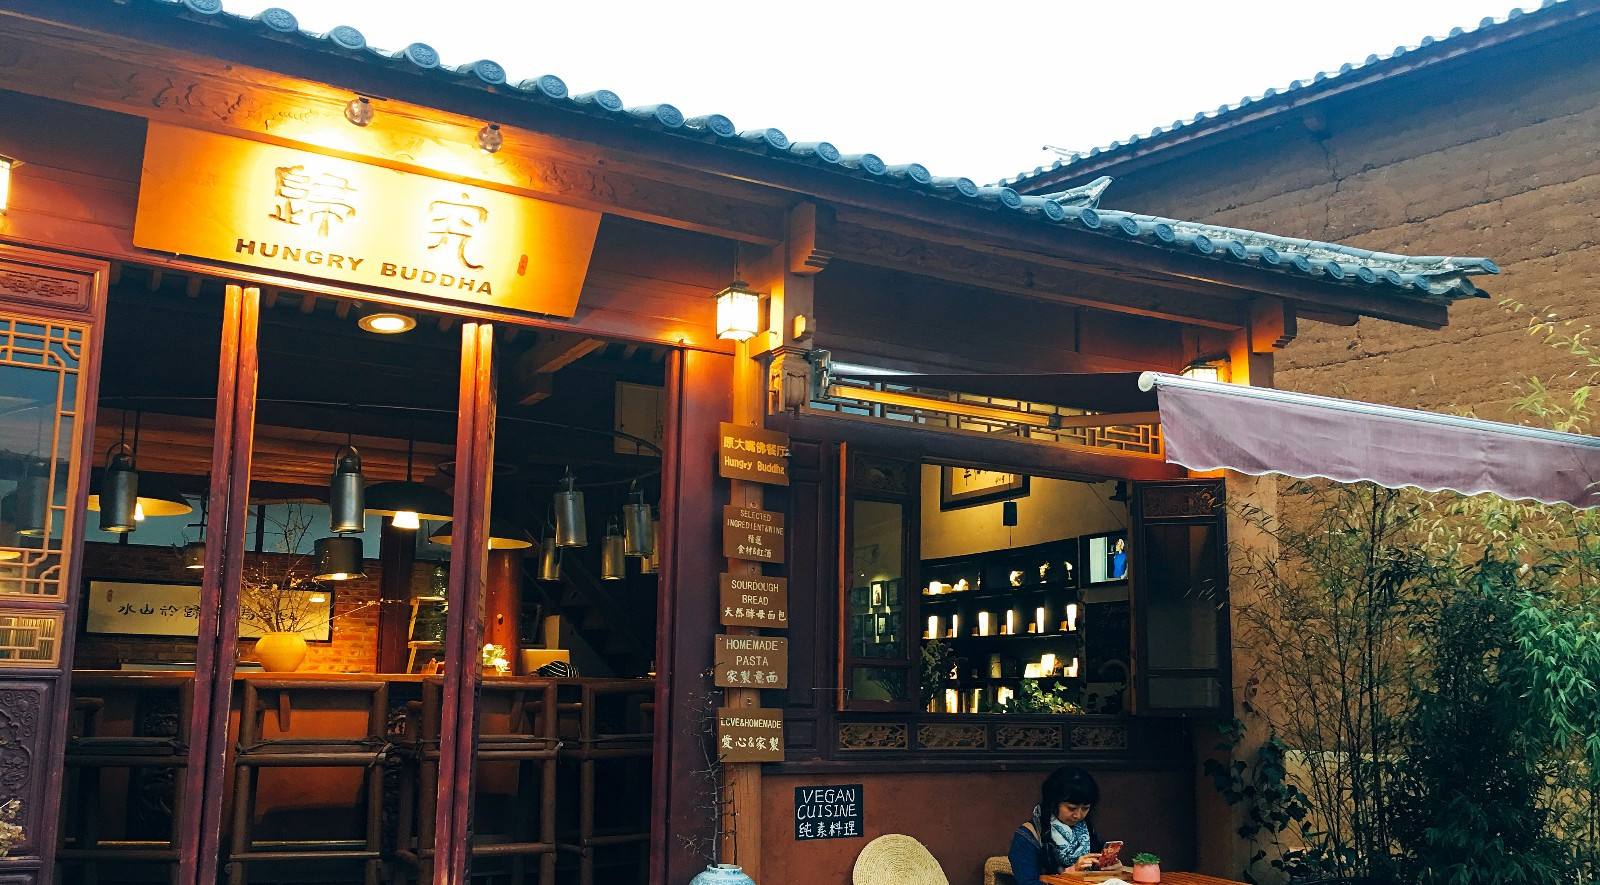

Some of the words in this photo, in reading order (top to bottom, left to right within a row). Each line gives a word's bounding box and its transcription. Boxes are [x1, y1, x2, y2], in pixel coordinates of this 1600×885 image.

[235, 238, 365, 272] HUNGRY
[380, 262, 494, 296] BUDDHA
[724, 455, 753, 470] Hungry
[757, 461, 785, 475] Buddha
[740, 509, 772, 522] SELECTED
[731, 579, 779, 593] SOURDOUGH
[742, 594, 769, 606] BREAD
[726, 639, 779, 651] HOMEMADE
[736, 655, 769, 666] PASTA
[720, 717, 782, 729] LOVE&HOMEMADE
[802, 788, 855, 804] VEGAN
[797, 803, 858, 820] CUISINE
[798, 820, 858, 838] 纯素料理
